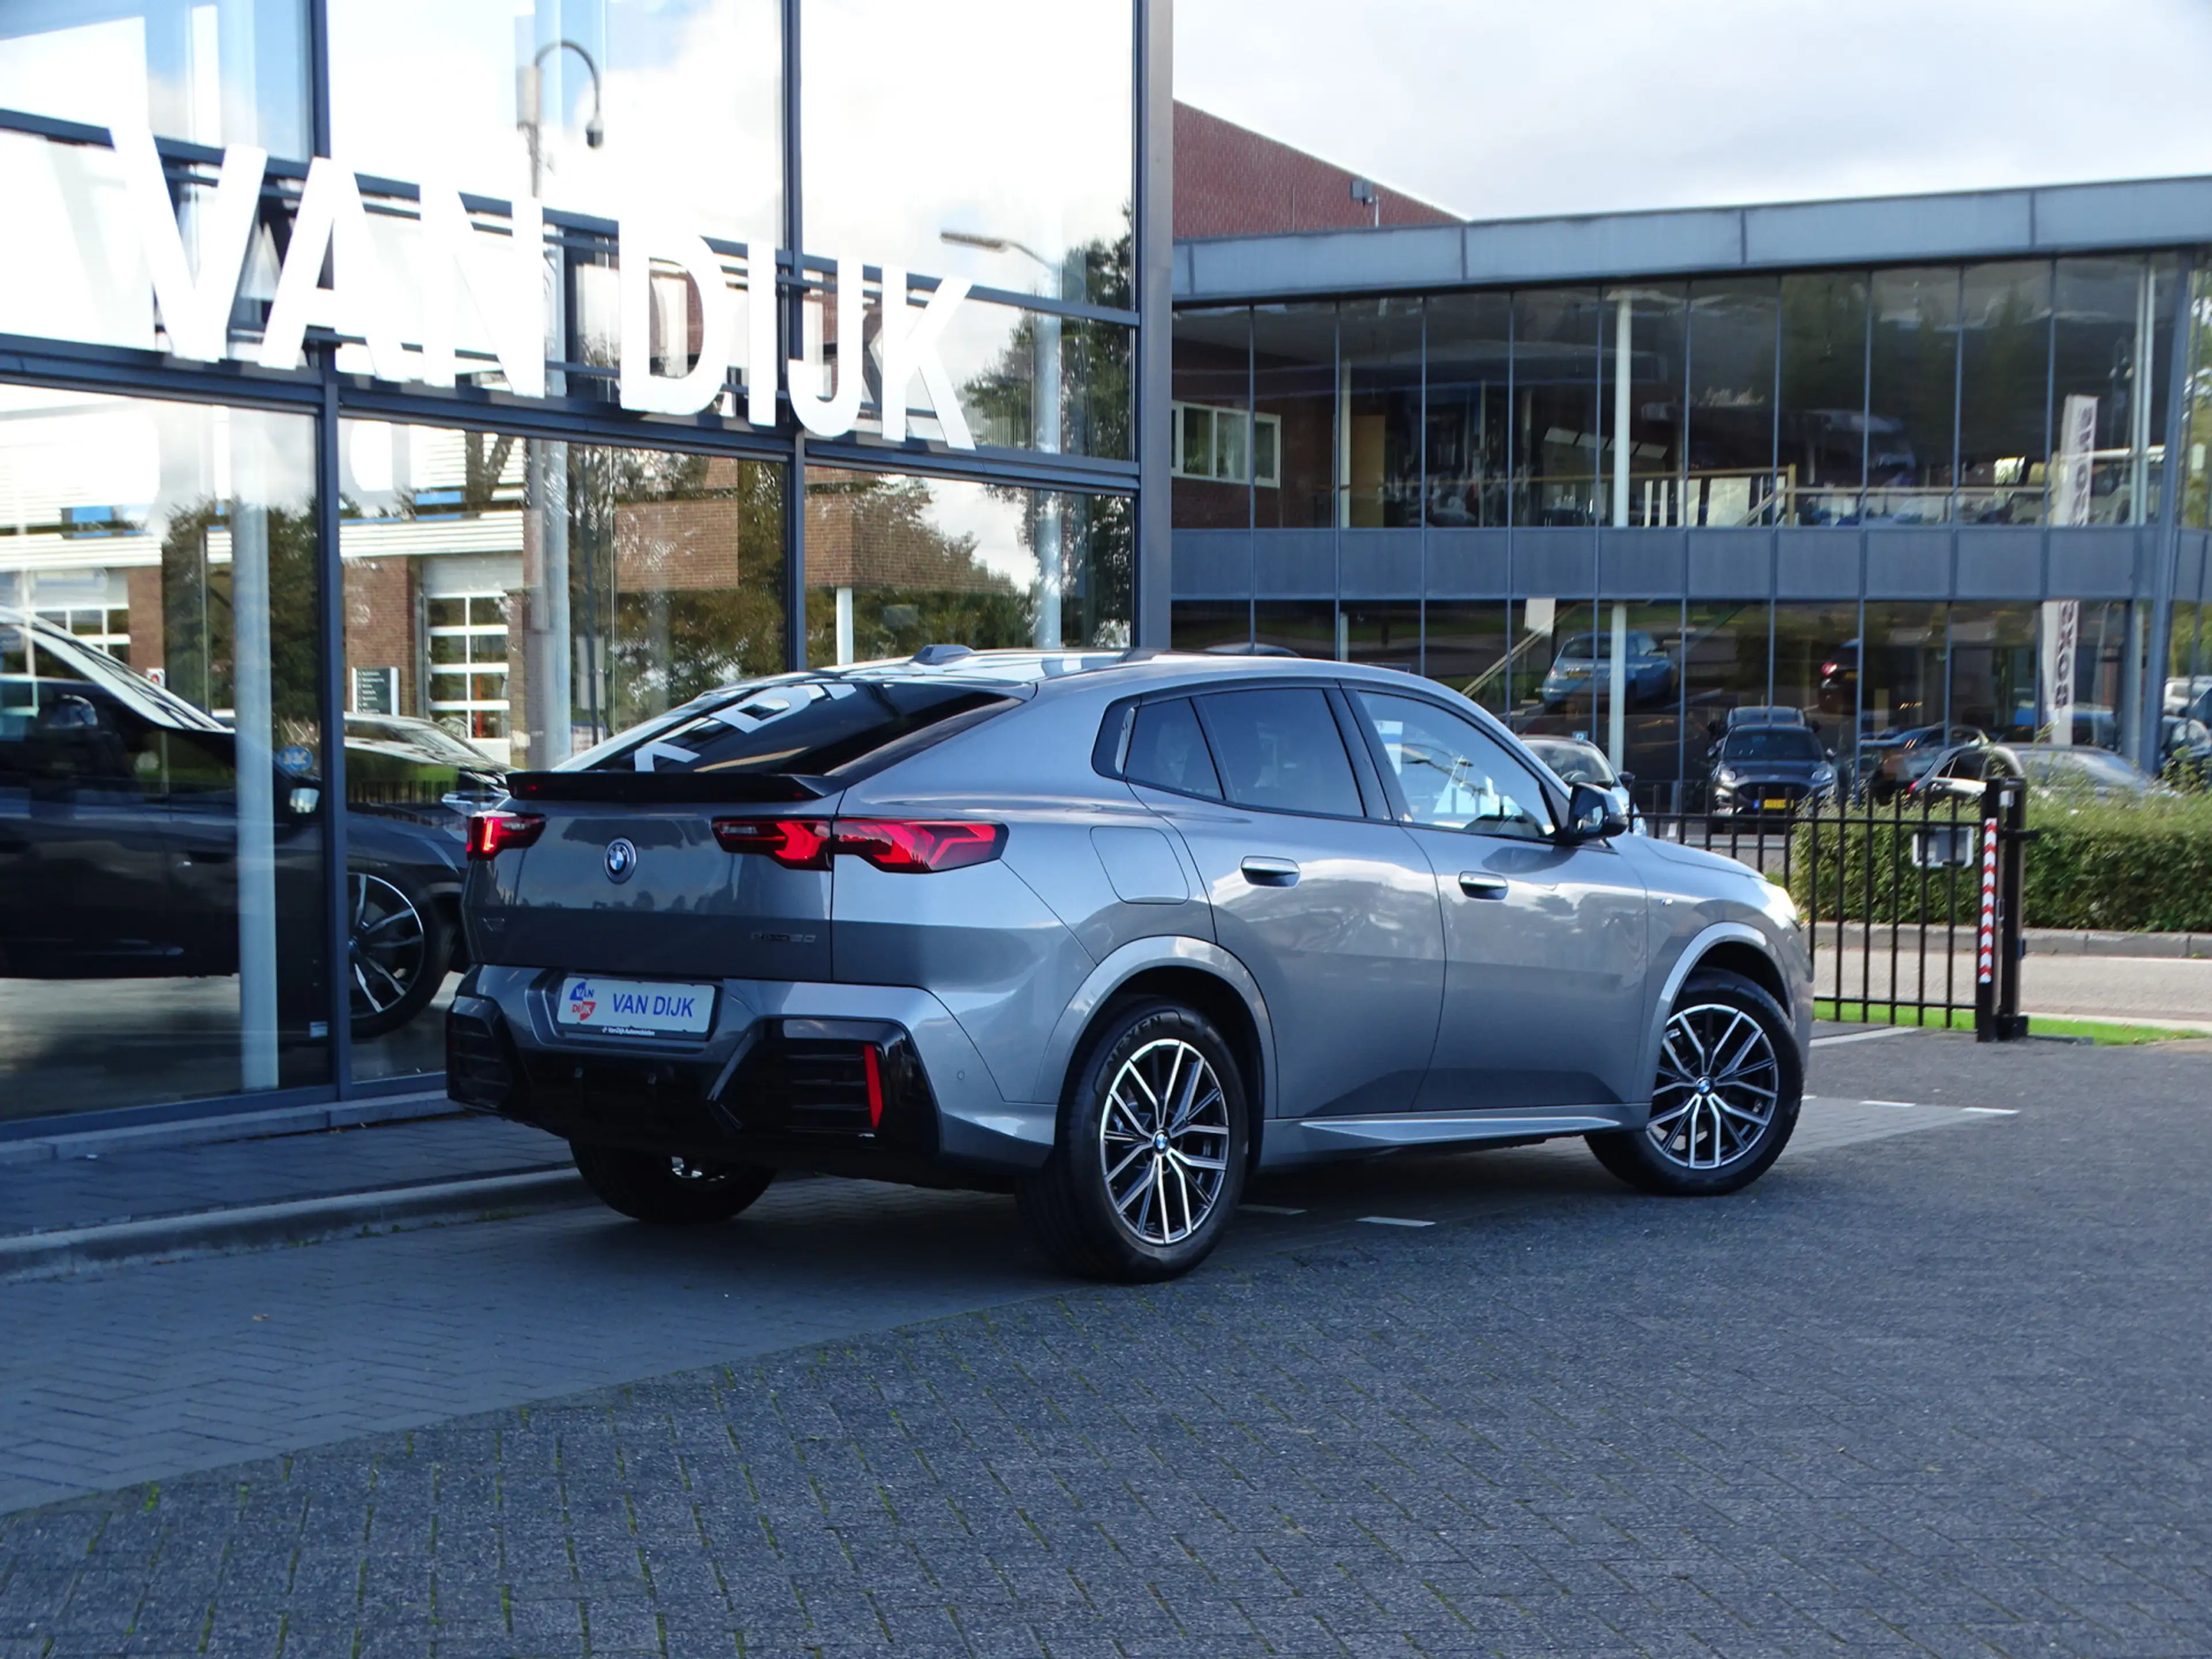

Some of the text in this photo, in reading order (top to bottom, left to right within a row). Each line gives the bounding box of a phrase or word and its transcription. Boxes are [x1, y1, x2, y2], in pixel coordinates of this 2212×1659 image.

[109, 123, 976, 451] VAN DIJK
[613, 993, 696, 1018] VAN DIJK
